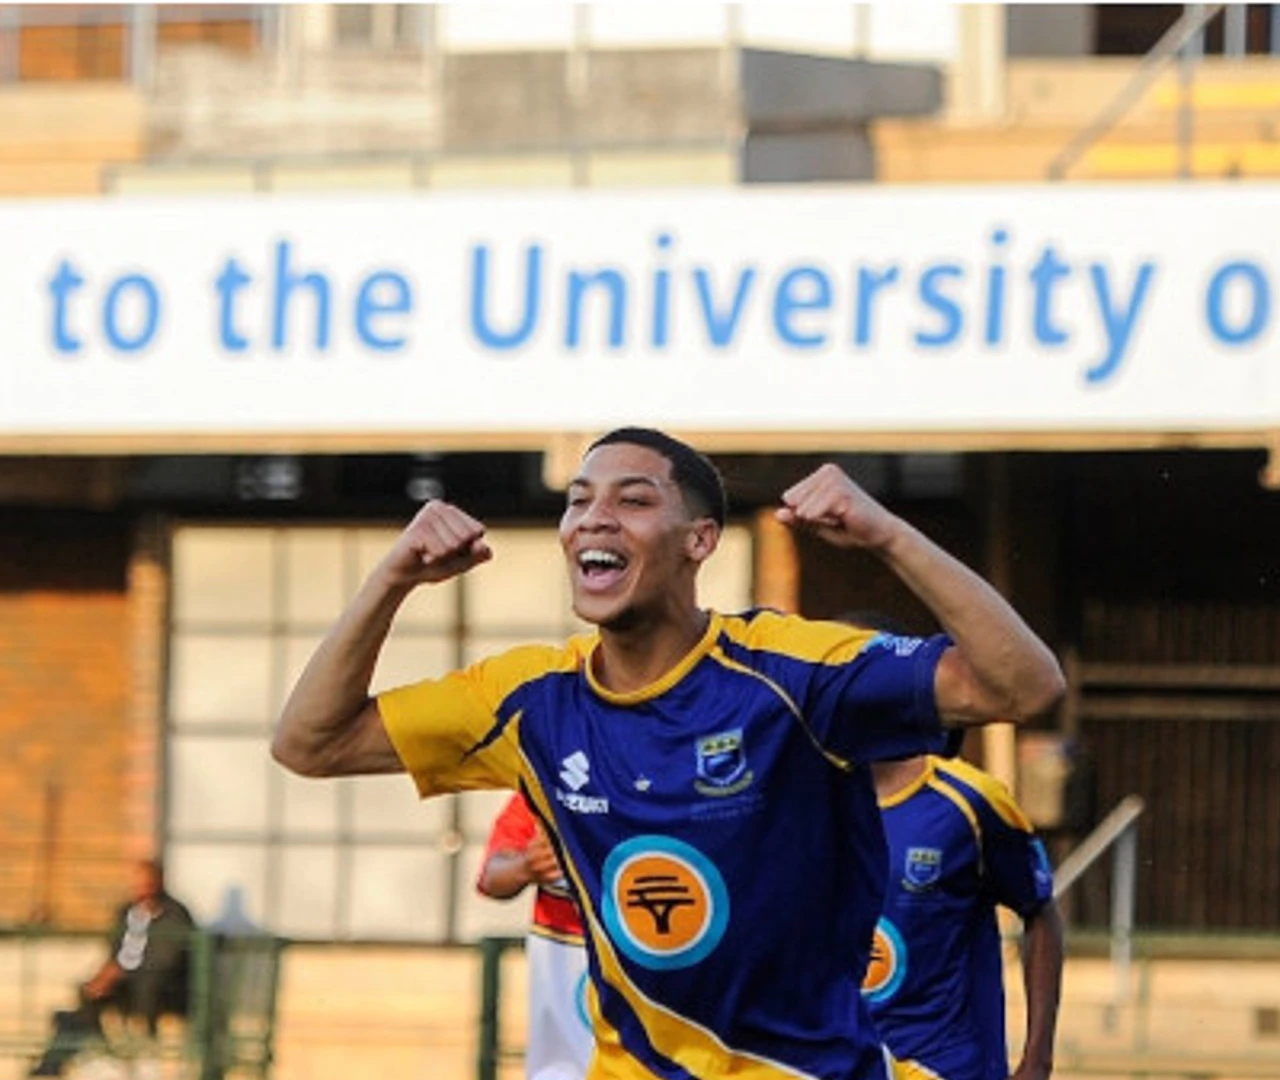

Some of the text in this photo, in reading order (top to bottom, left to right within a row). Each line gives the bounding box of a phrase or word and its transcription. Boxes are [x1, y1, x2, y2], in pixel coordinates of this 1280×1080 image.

[46, 258, 162, 354] to
[212, 239, 414, 353] the
[468, 227, 1155, 384] University
